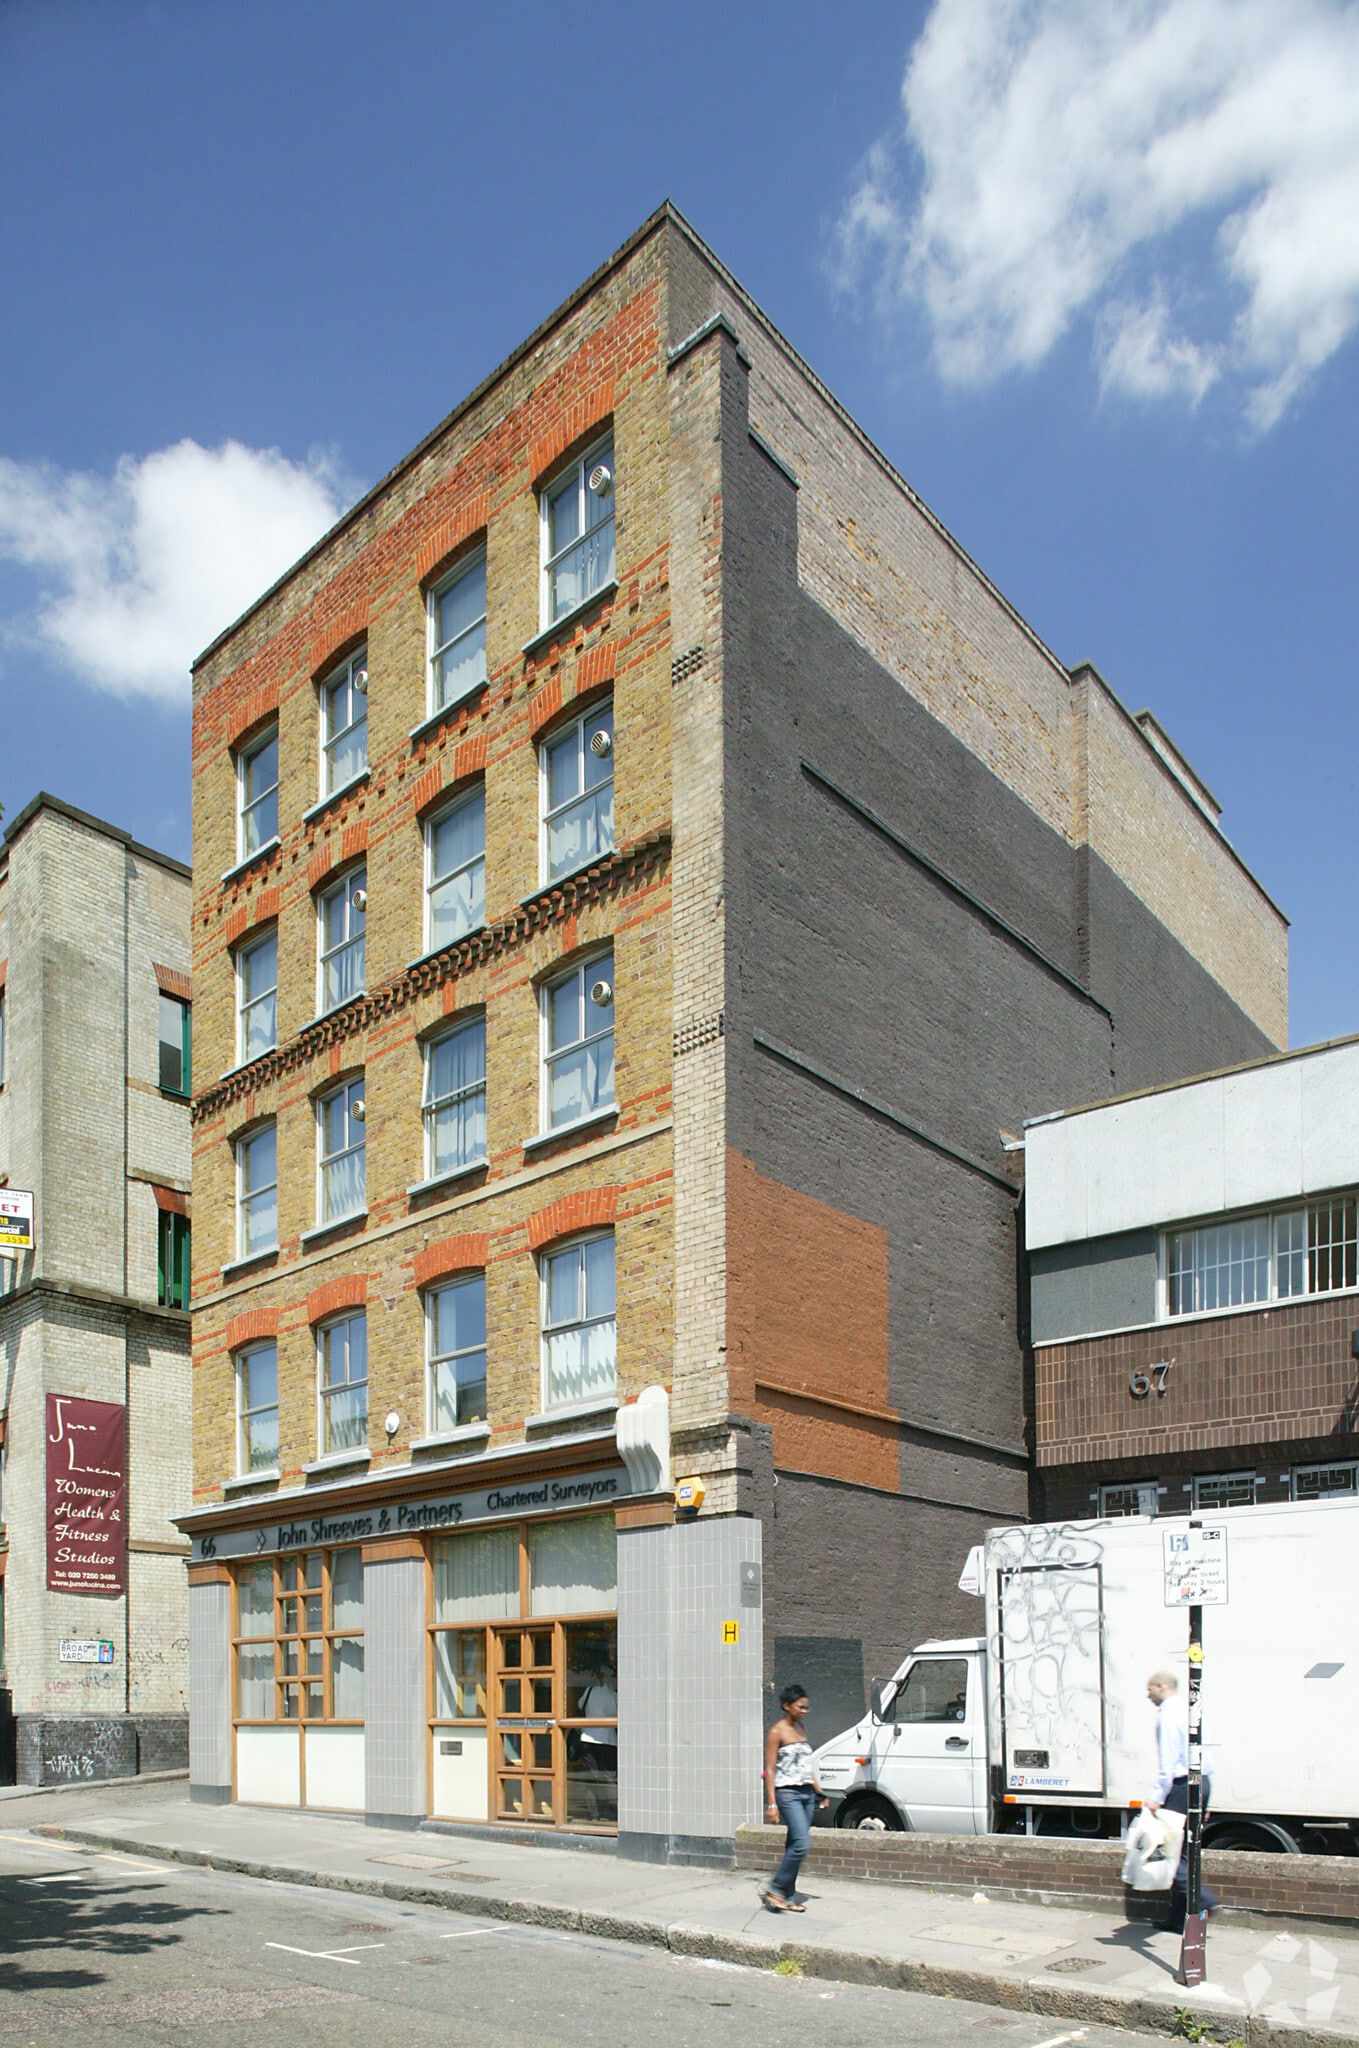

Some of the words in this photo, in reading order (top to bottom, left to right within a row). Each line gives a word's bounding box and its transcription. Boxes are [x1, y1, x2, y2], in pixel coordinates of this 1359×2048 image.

[6, 1235, 30, 1245] 3553
[1129, 1361, 1170, 1396] 67
[49, 1398, 96, 1443] Juno
[68, 1437, 121, 1477] Lucina
[54, 1478, 116, 1499] Womens
[54, 1501, 105, 1520] Health
[109, 1509, 121, 1521] &
[201, 1537, 217, 1558] 66
[277, 1522, 307, 1550] John
[310, 1518, 372, 1542] Shreeves
[378, 1509, 391, 1533] &
[397, 1500, 462, 1526] Partners
[487, 1483, 548, 1511] Chartered
[551, 1477, 617, 1501] Surveyors
[53, 1524, 110, 1542] Fitness
[54, 1547, 116, 1565] Studios
[723, 1623, 737, 1642] H
[61, 1643, 88, 1652] BROAD
[61, 1652, 83, 1660] YARD
[1024, 1777, 1070, 1786] LAMBERET
